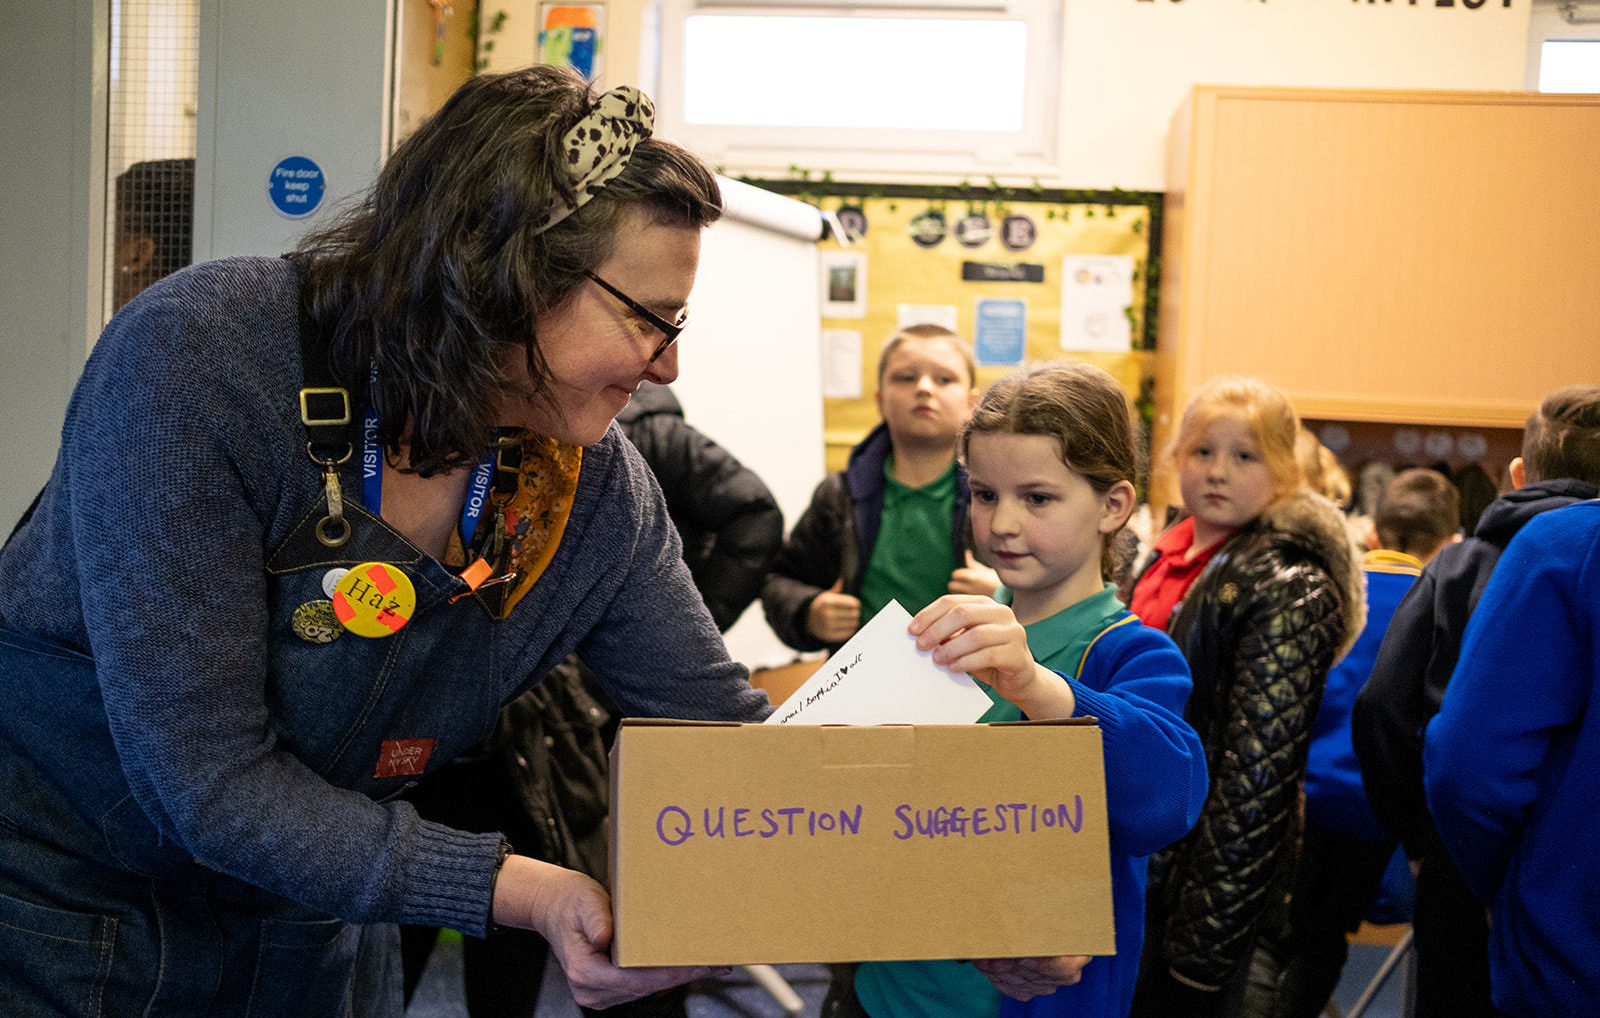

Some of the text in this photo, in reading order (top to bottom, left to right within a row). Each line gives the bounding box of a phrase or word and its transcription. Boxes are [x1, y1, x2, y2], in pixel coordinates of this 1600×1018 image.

[275, 168, 319, 179] Fire door
[285, 181, 310, 191] keep
[286, 193, 308, 203] shut
[363, 417, 378, 479] VISITOR
[466, 463, 492, 519] VISITOR
[345, 576, 401, 618] Haz
[655, 795, 1083, 847] QUESTION SUGGESTION
